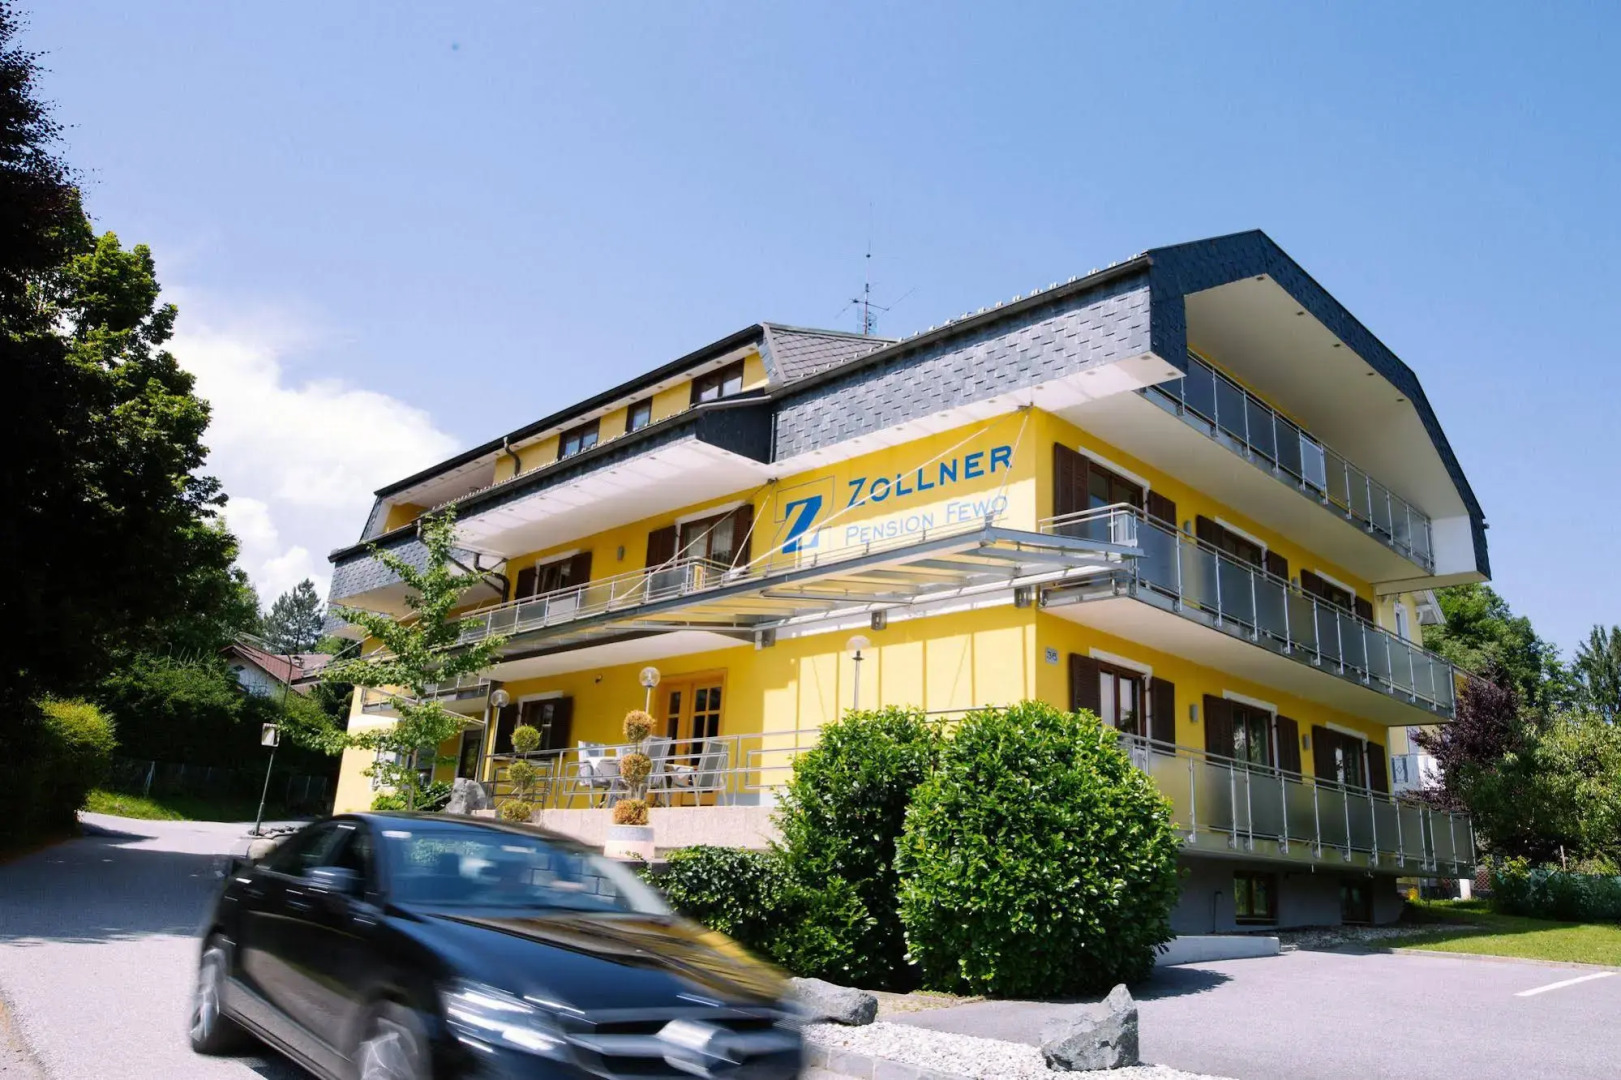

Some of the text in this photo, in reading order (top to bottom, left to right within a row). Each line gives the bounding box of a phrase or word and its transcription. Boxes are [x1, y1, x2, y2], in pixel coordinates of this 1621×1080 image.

[846, 445, 1013, 508] ZOLLNER
[845, 495, 1009, 546] PENSION FEWO
